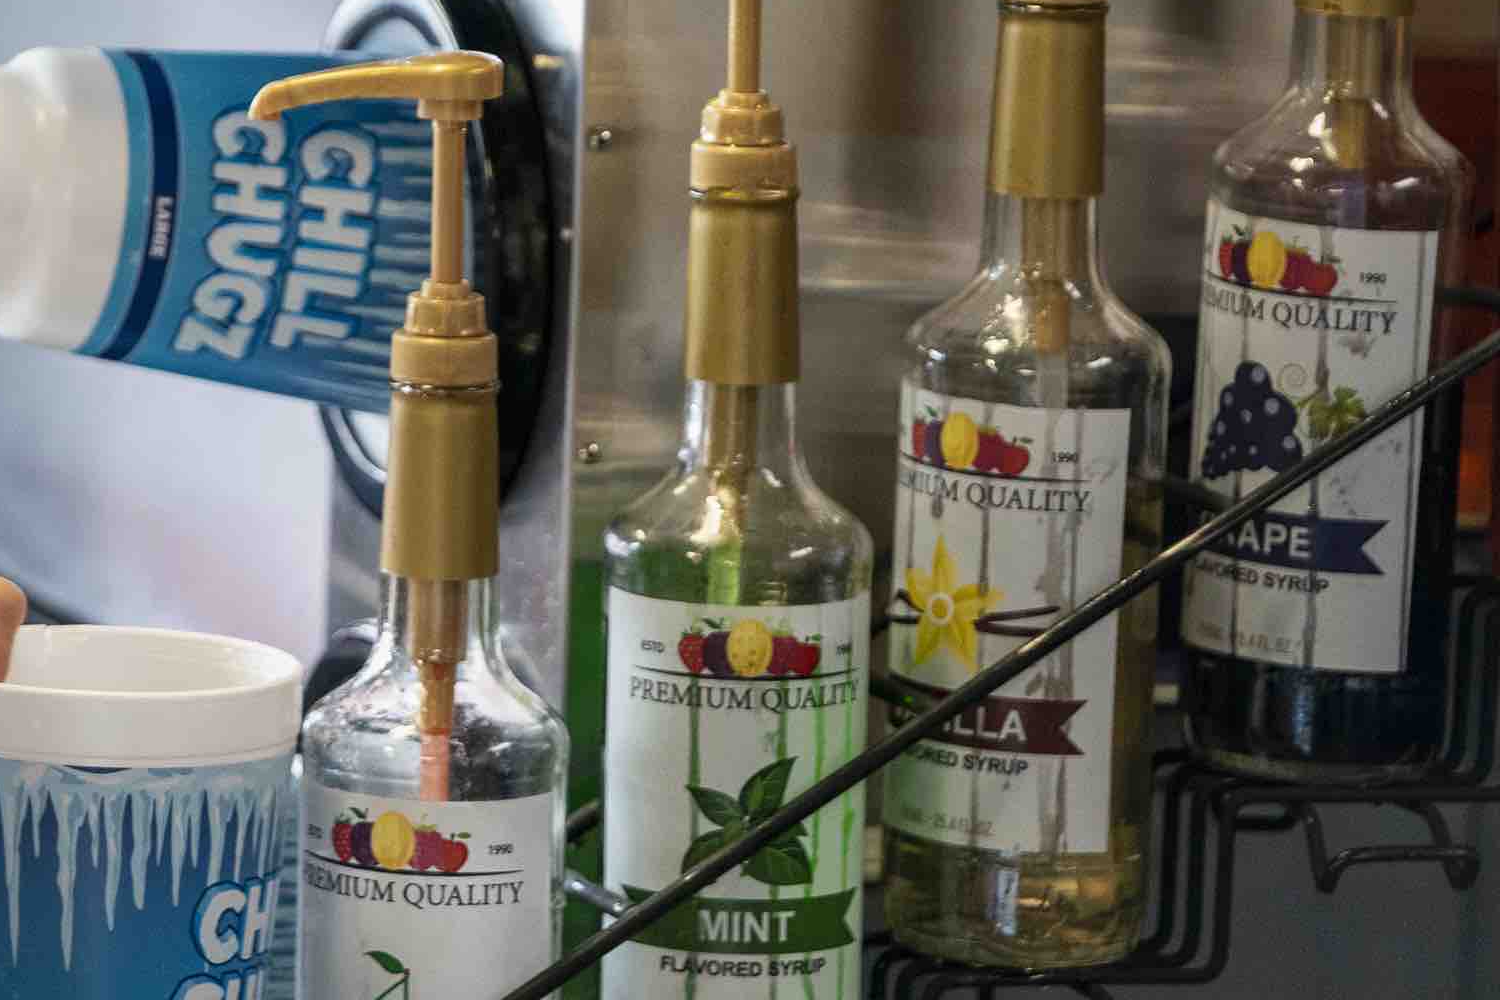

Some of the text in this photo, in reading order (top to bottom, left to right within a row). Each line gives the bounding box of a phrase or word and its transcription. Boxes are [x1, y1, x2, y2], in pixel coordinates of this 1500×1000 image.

[173, 109, 288, 361] CHUGZ
[270, 126, 374, 348] CHILL
[1272, 301, 1398, 334] QUALITY
[966, 482, 1092, 512] QUALITY
[1206, 511, 1312, 558] APE
[1263, 571, 1330, 594] SYRUP
[630, 676, 753, 710] PREMIUM
[963, 753, 1029, 775] SYRUP
[402, 880, 525, 909] QUALITY
[699, 908, 797, 943] MINT
[660, 954, 827, 977] FLAVORED SYRUP
